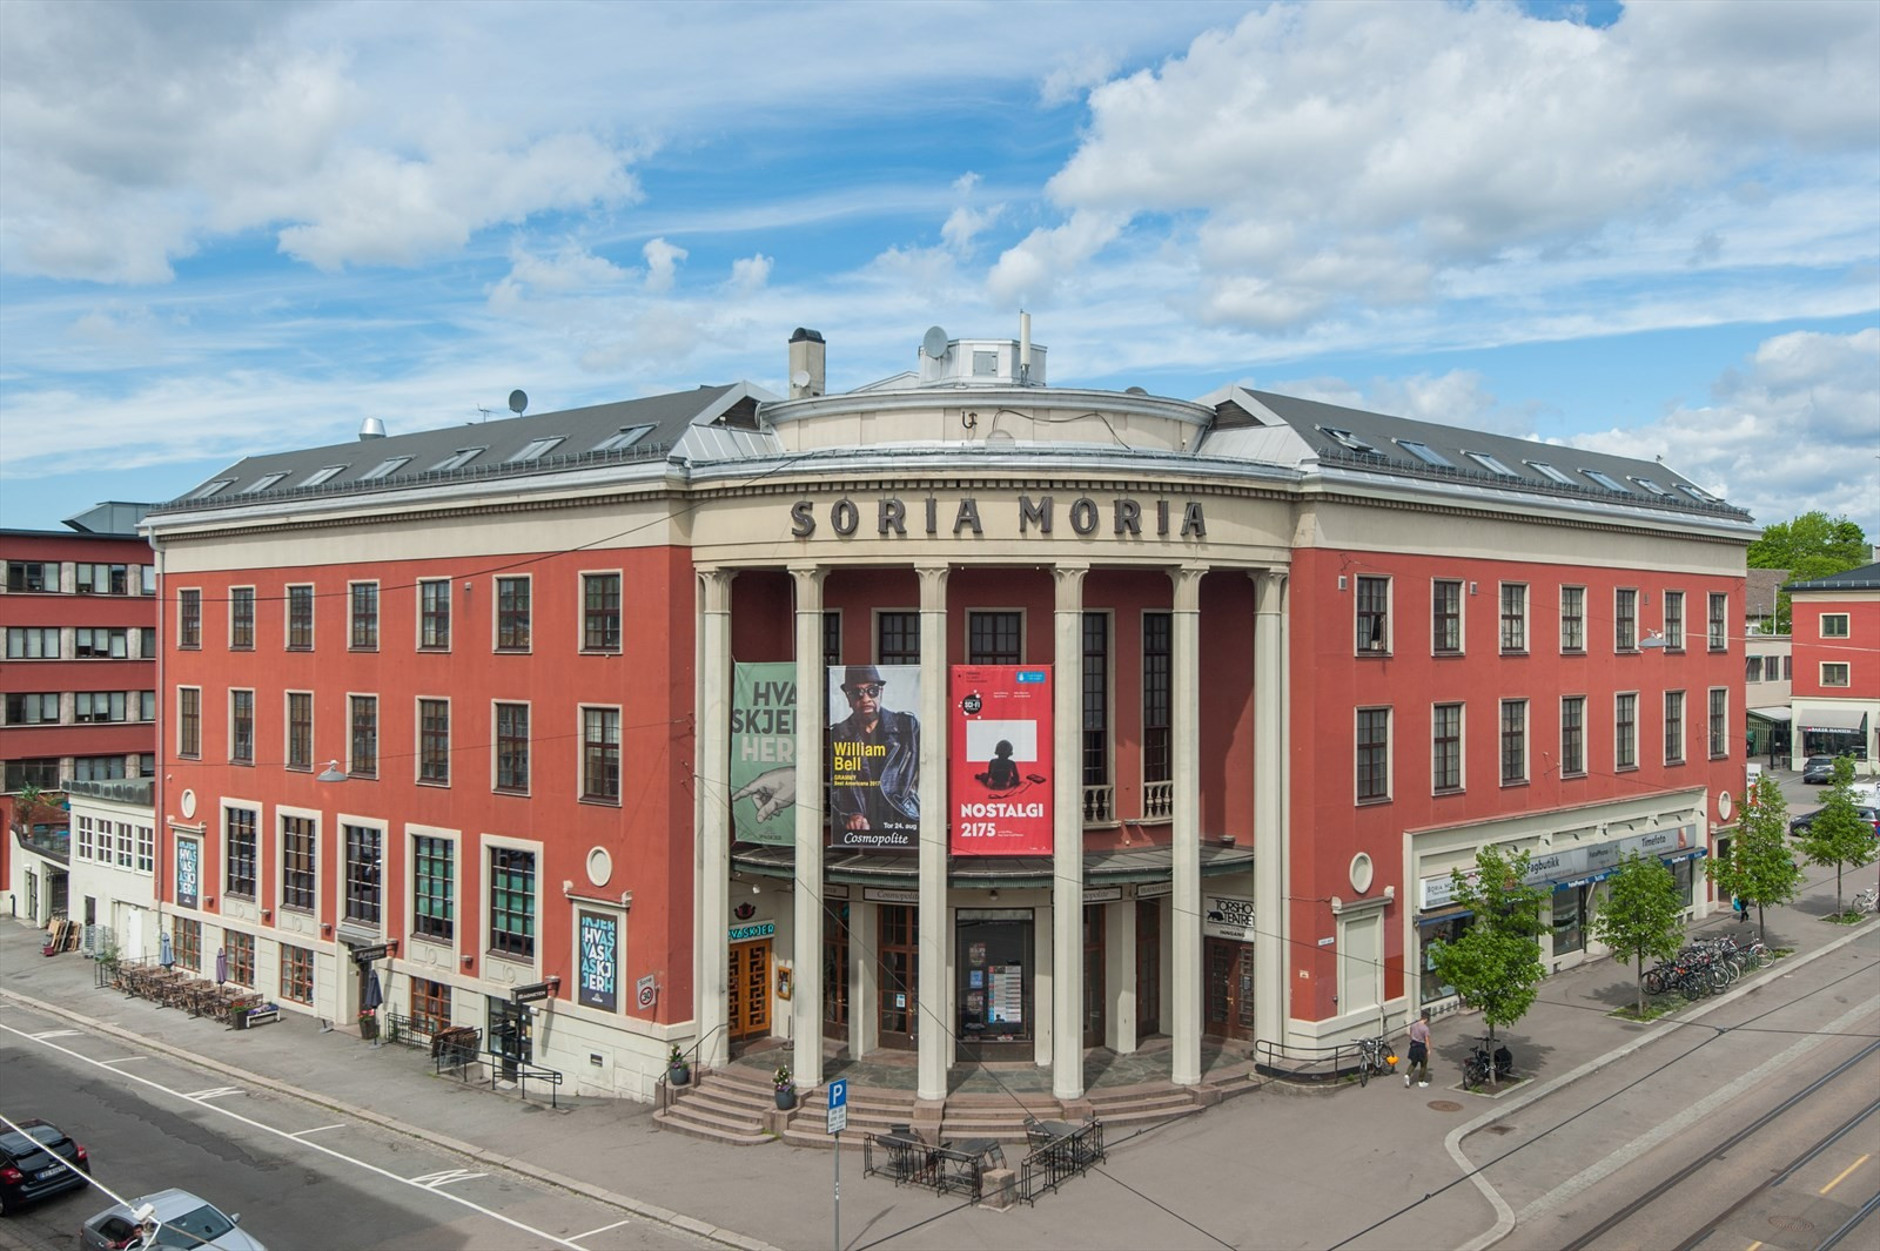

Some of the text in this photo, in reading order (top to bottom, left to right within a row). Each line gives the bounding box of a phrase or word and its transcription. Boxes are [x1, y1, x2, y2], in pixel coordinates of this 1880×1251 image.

[791, 495, 1207, 538] SORIA MORIA
[741, 736, 794, 762] HER
[833, 742, 886, 757] William
[834, 757, 861, 771] Bell
[961, 803, 1043, 817] NOSTALGI
[905, 823, 917, 831] aug
[961, 822, 996, 837] 2175
[844, 832, 909, 847] Cosmopolite
[728, 923, 775, 940] VASKJER
[642, 990, 652, 1001] 30
[833, 1084, 843, 1105] P
